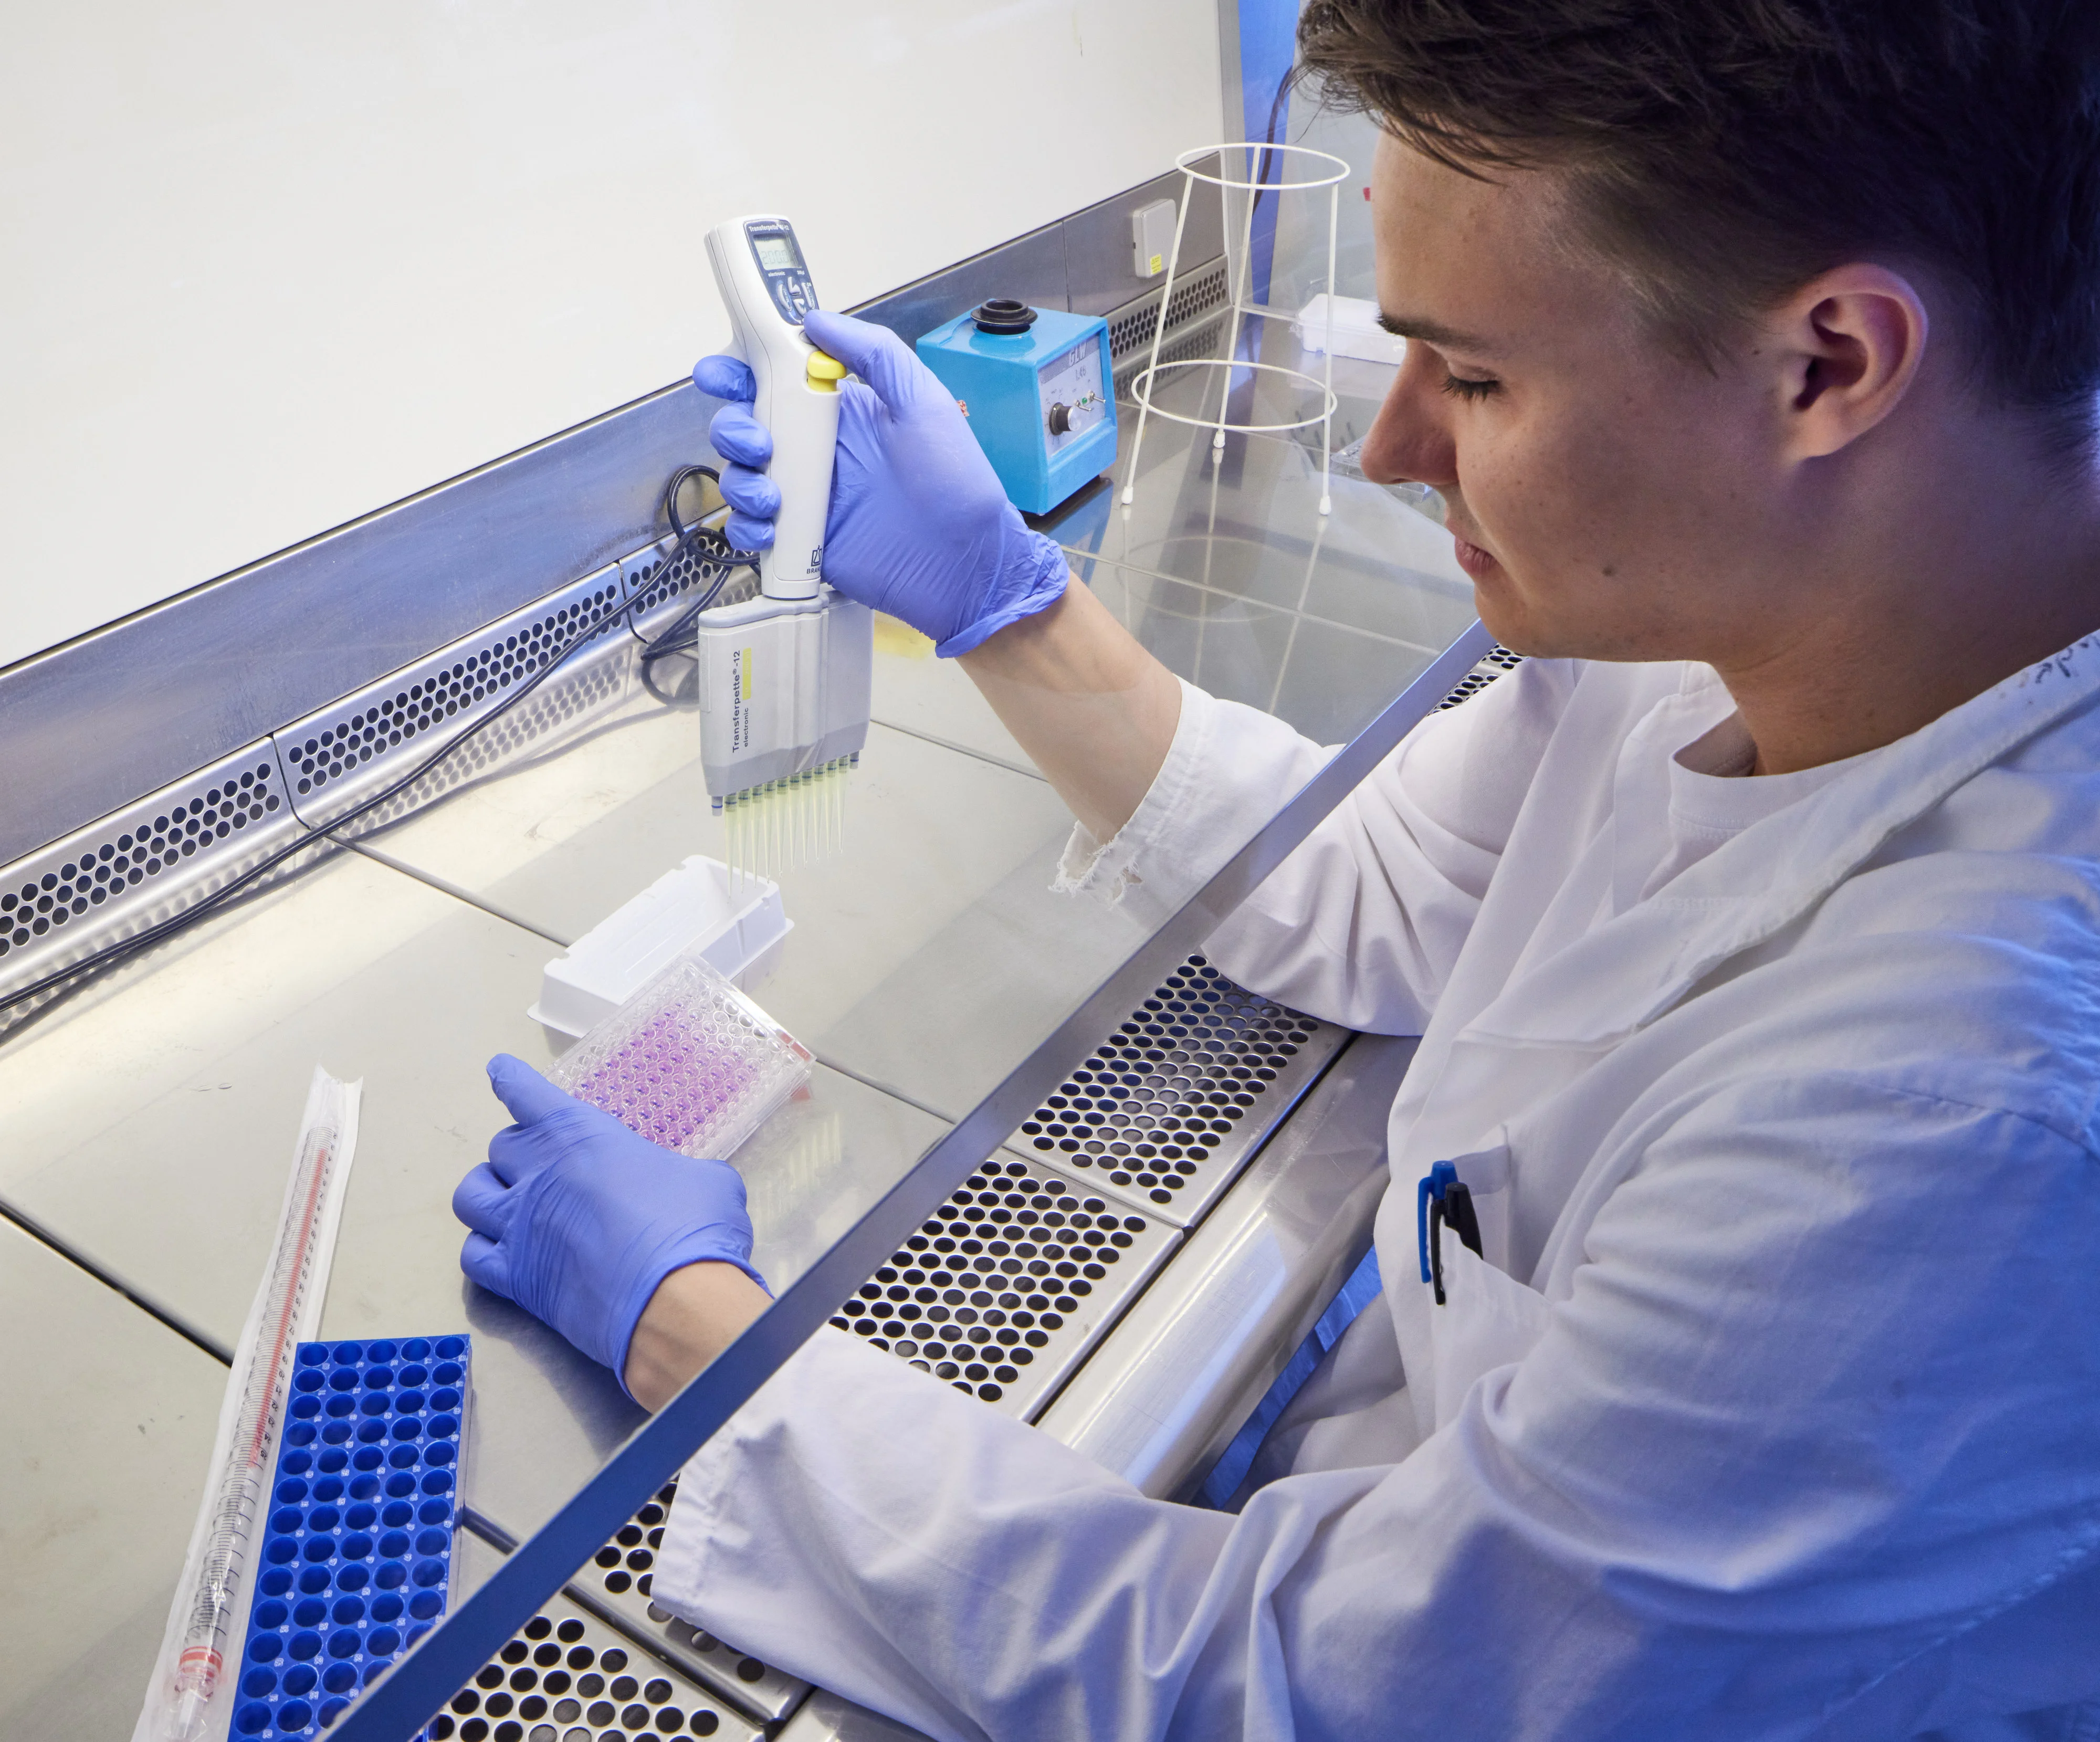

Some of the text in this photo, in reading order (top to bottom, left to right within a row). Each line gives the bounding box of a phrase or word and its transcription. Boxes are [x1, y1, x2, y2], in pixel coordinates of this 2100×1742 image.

[305, 1257, 310, 1266] 12
[302, 1270, 307, 1279] 13
[299, 1284, 303, 1293] 14
[296, 1298, 300, 1307] 15
[292, 1313, 298, 1321] 16
[289, 1327, 295, 1336] 17
[286, 1341, 291, 1350] 18
[282, 1356, 288, 1365] 19
[279, 1371, 285, 1381] 20
[276, 1387, 281, 1396] 21
[272, 1402, 278, 1412] 22
[268, 1418, 275, 1428] 23
[265, 1434, 271, 1444] 24
[260, 1450, 267, 1460] 25
